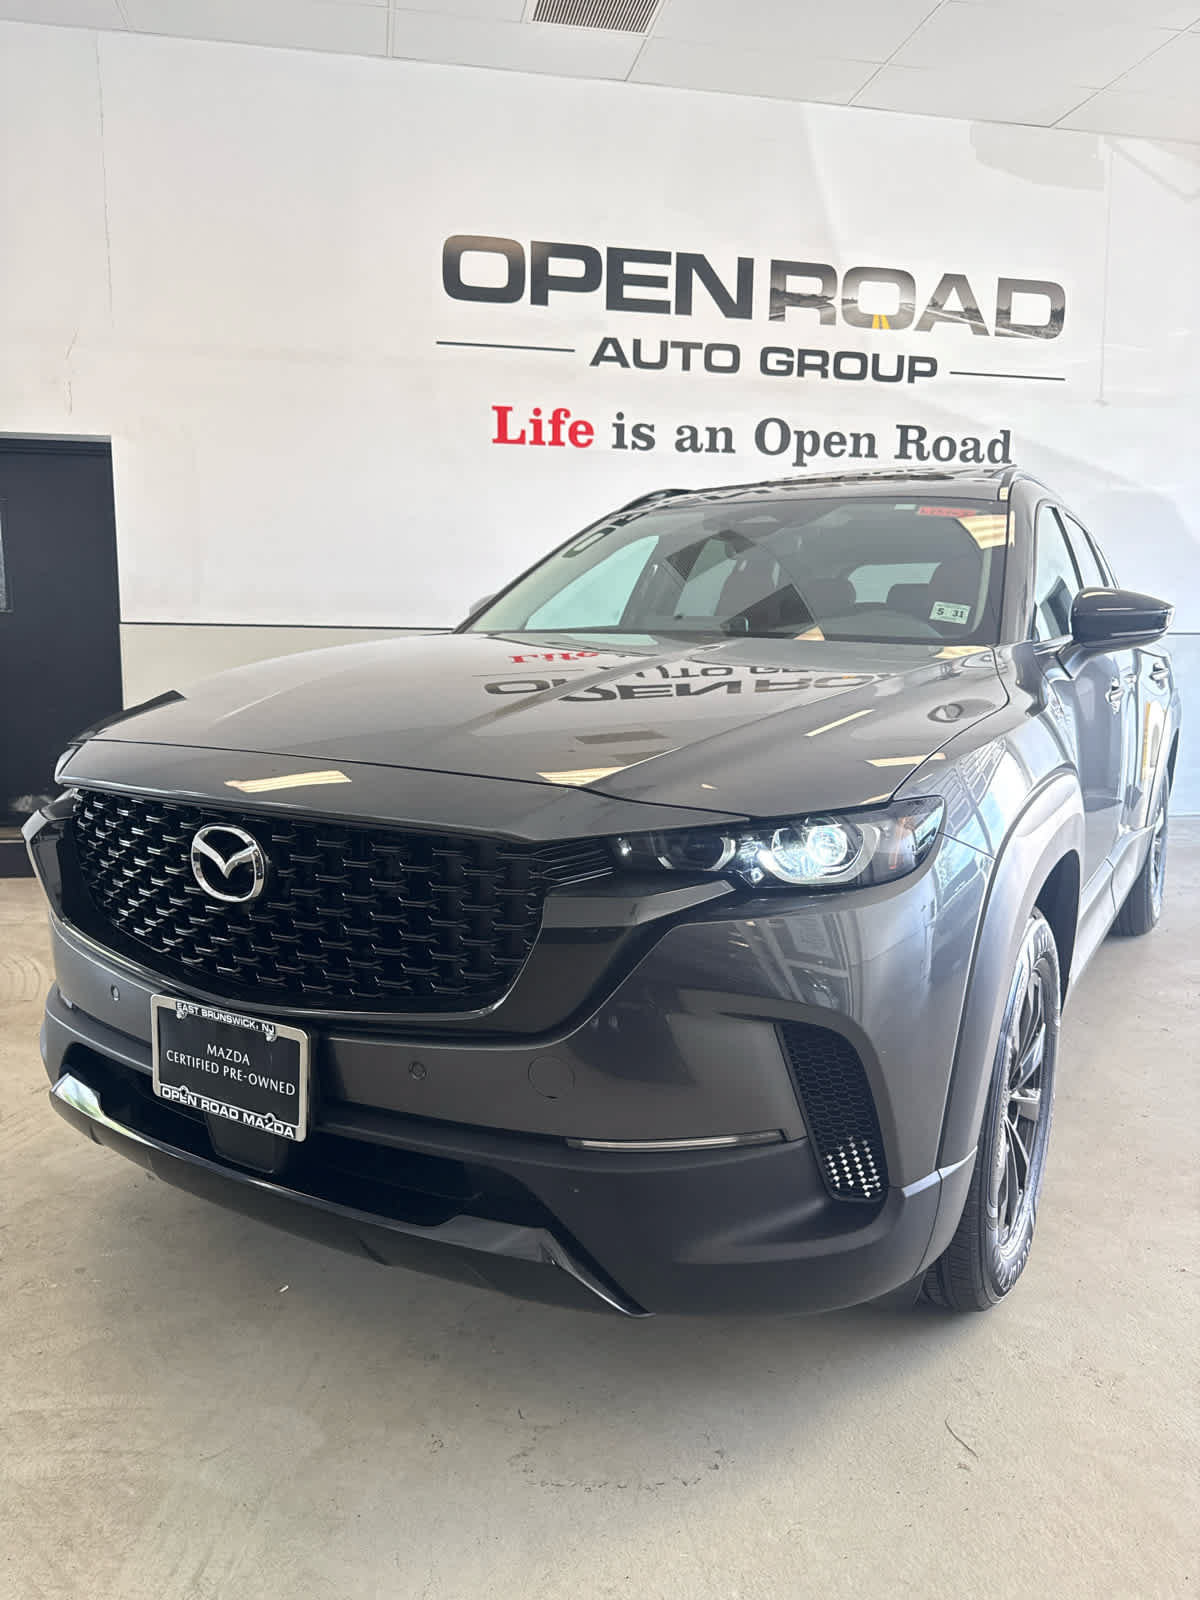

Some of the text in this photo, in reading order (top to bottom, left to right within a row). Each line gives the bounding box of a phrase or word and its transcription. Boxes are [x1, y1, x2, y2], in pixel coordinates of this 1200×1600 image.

[443, 234, 1067, 340] OPEN ROAD
[589, 336, 938, 384] AUTO GROUP
[491, 405, 1013, 466] Life is an Open Road
[935, 607, 945, 616] 5
[176, 1002, 200, 1016] EAST
[261, 1023, 275, 1033] NJ
[166, 1049, 296, 1096] CERTIFIED PRE-OWNED
[207, 1043, 250, 1066] MAZDA
[162, 1087, 294, 1138] OPEN ROAD MAZDA
